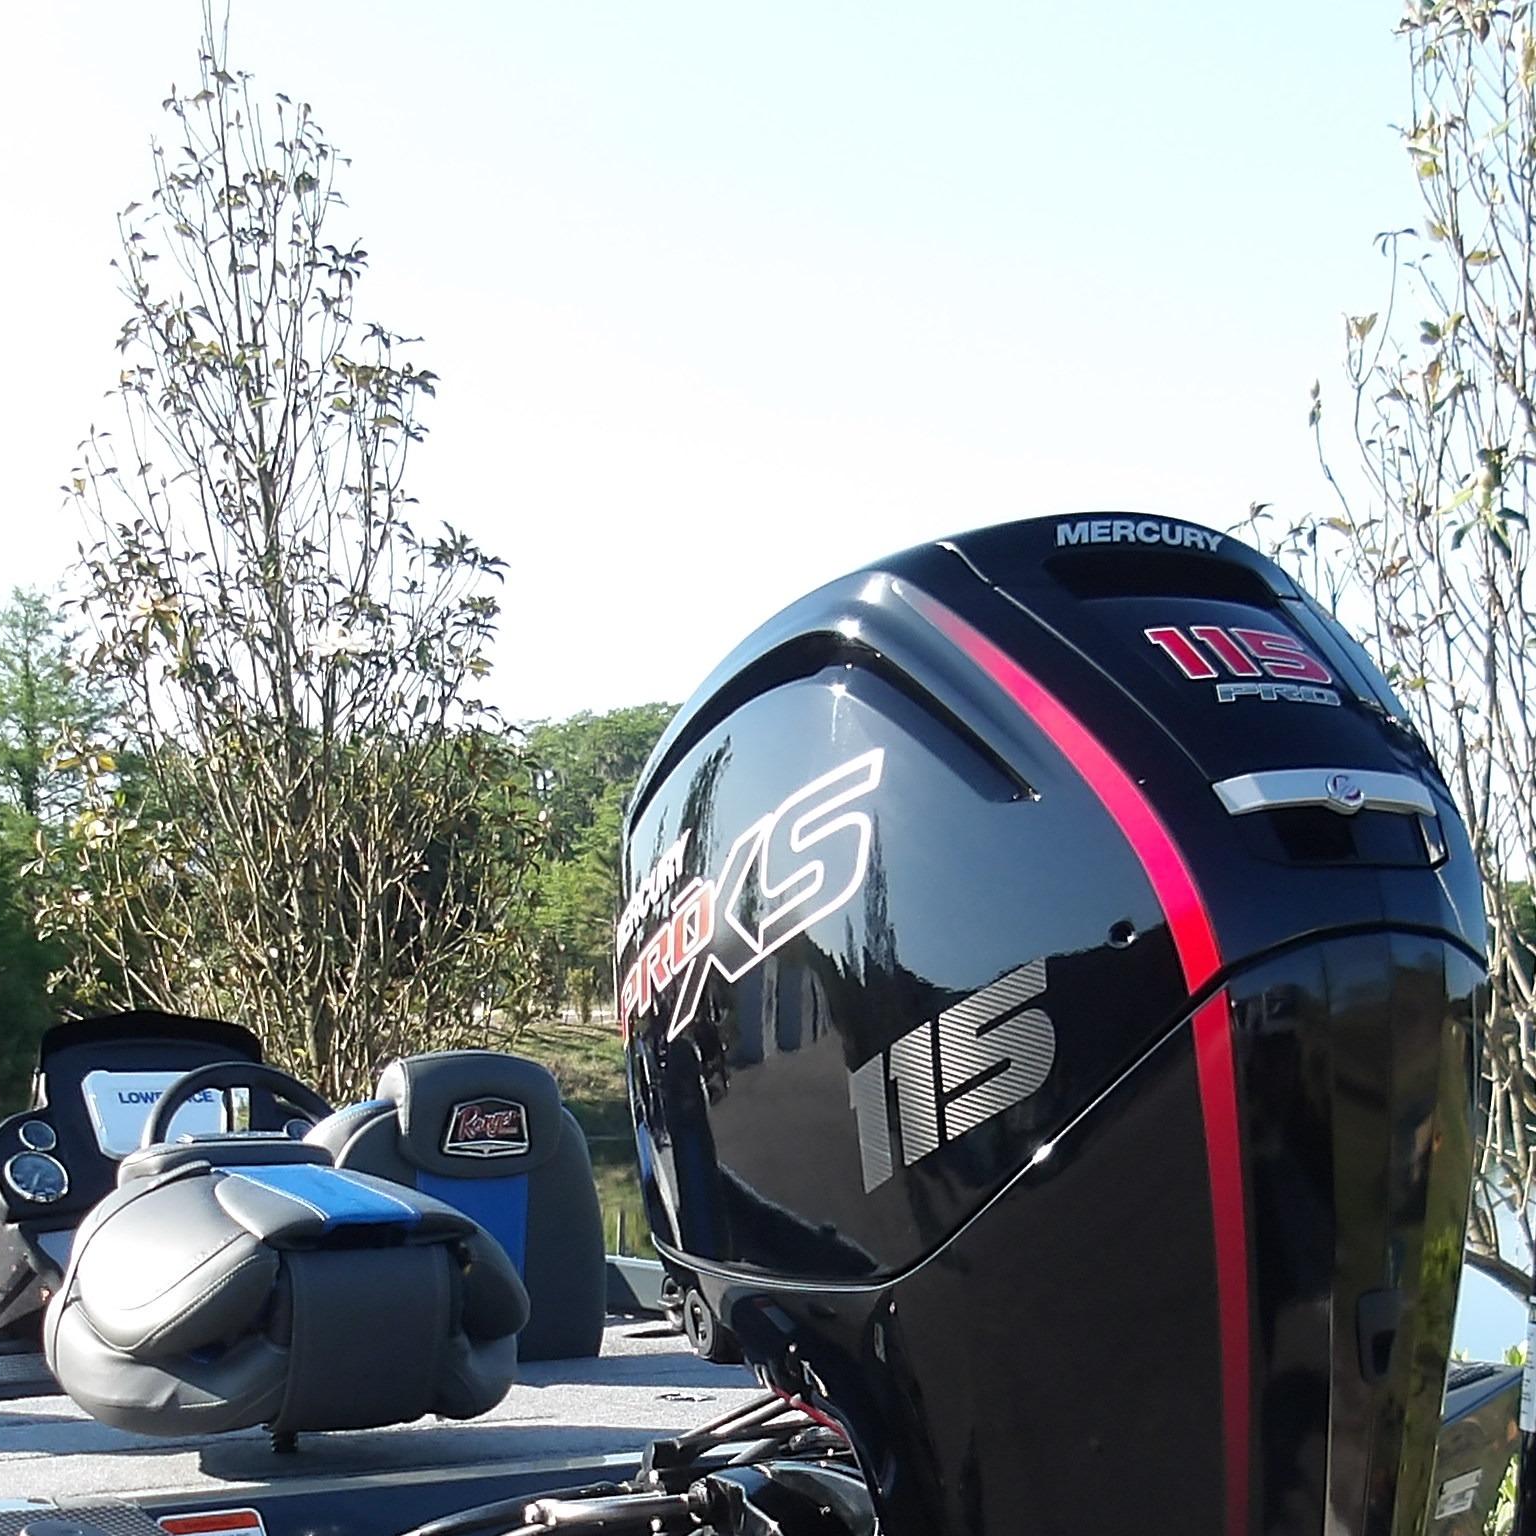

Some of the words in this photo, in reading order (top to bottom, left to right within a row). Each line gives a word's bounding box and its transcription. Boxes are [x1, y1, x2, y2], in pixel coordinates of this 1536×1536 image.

[1056, 519, 1224, 552] MERCURY
[1143, 625, 1333, 685] 115
[1215, 682, 1342, 708] PRO
[847, 956, 1057, 1195] 115
